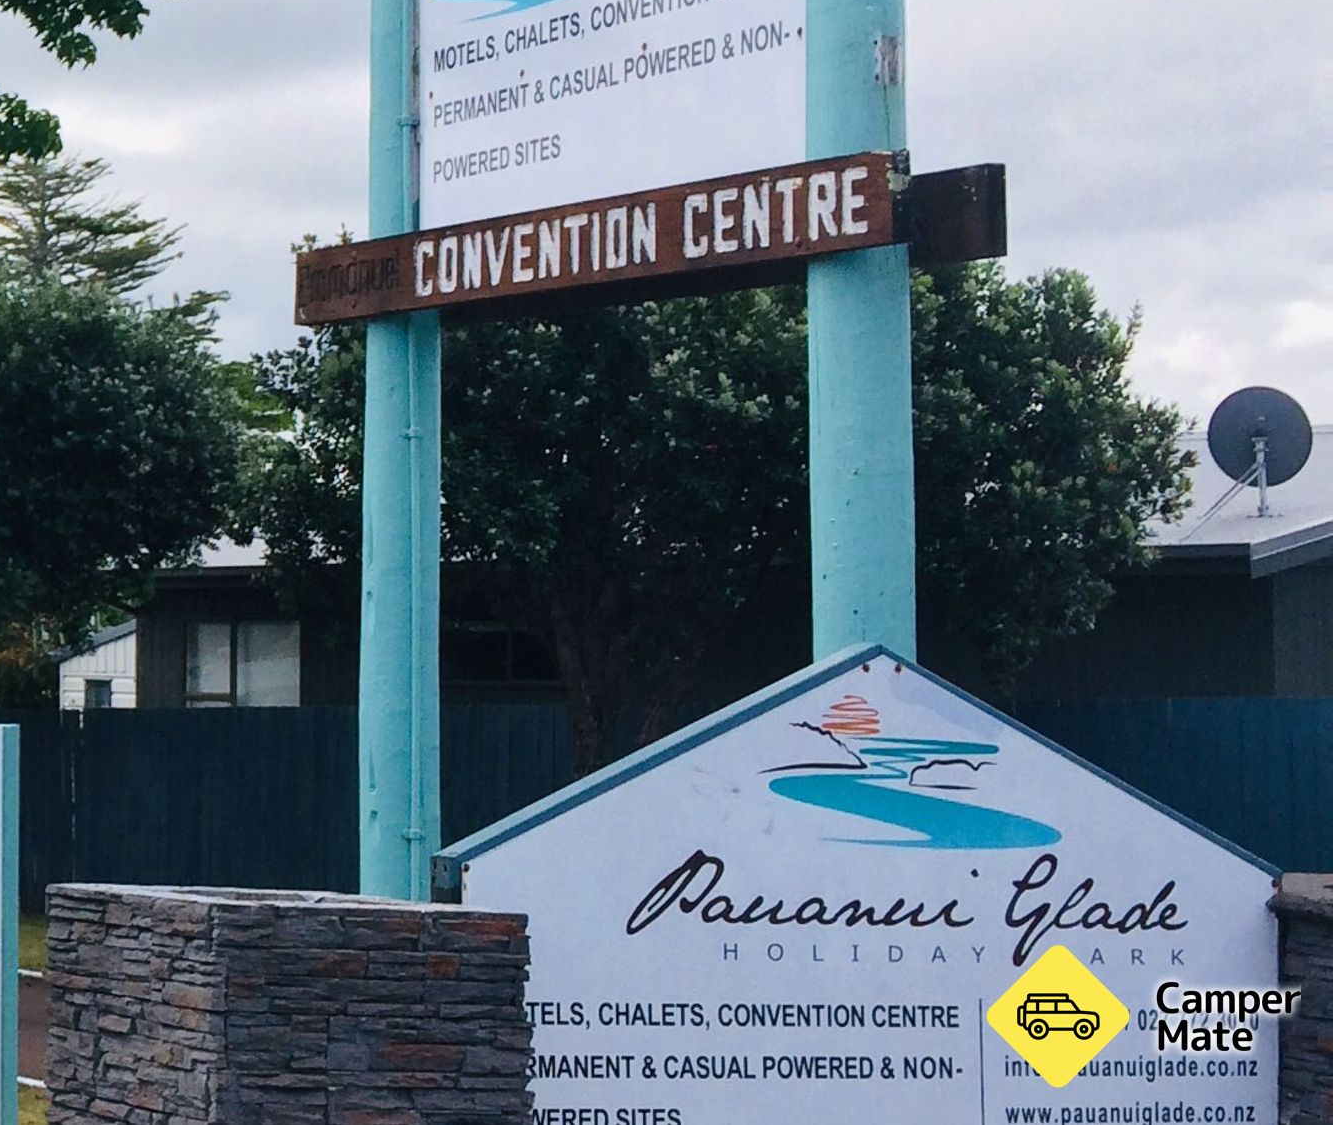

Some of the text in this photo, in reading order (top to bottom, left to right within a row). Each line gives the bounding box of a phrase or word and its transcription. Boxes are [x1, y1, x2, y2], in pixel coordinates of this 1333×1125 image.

[433, 35, 499, 73] MOTELS,
[504, 11, 585, 54] CHALETS,
[433, 20, 790, 128] PERMANENT & CASUAL POWERED & NON-
[433, 133, 562, 184] POWERED SITES
[413, 201, 656, 298] CONVENTION
[682, 166, 869, 259] CENTRE
[1004, 852, 1189, 967] Glade
[722, 942, 1186, 967] HOLIDAY ARK
[526, 1002, 960, 1031] TELS, CHALETS, CONVENTION CENTRE
[527, 1055, 963, 1079] RMANENT & CASUAL POWERED & NON-
[532, 1108, 681, 1125] WERED SITES
[1005, 1101, 1256, 1125] www.pauanuiglade.co.nz
